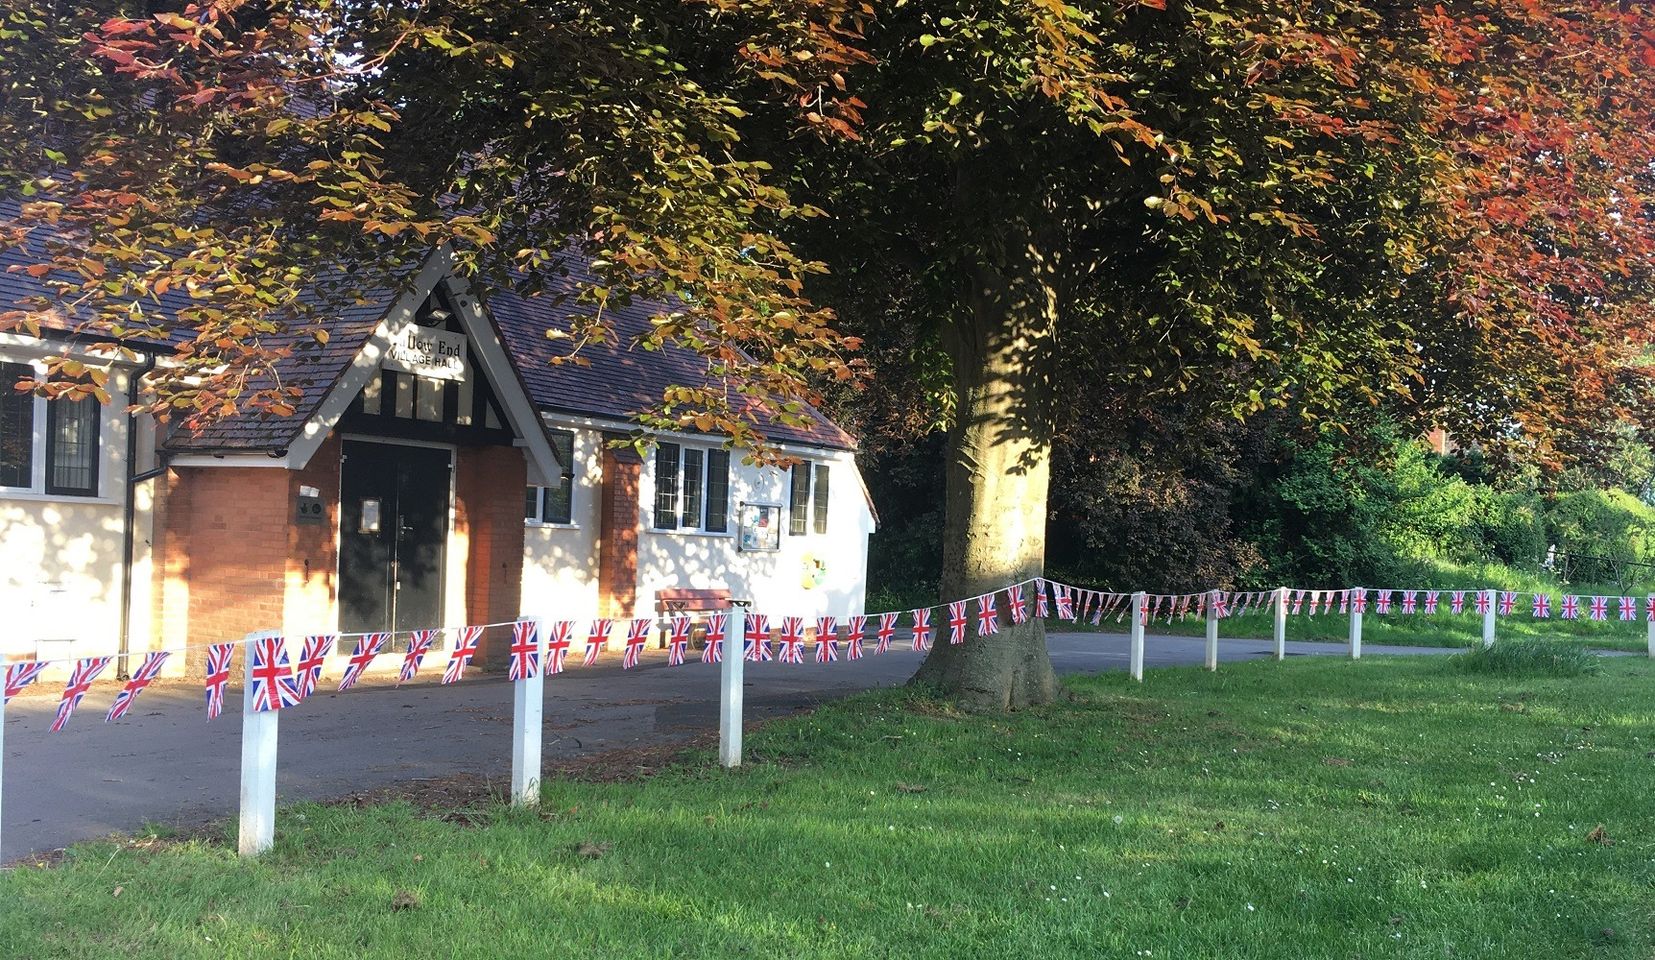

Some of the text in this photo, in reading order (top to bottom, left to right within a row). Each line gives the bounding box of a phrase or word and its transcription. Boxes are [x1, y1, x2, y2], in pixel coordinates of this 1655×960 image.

[391, 331, 460, 357] llow End
[390, 349, 459, 370] VILLAGE HALL
